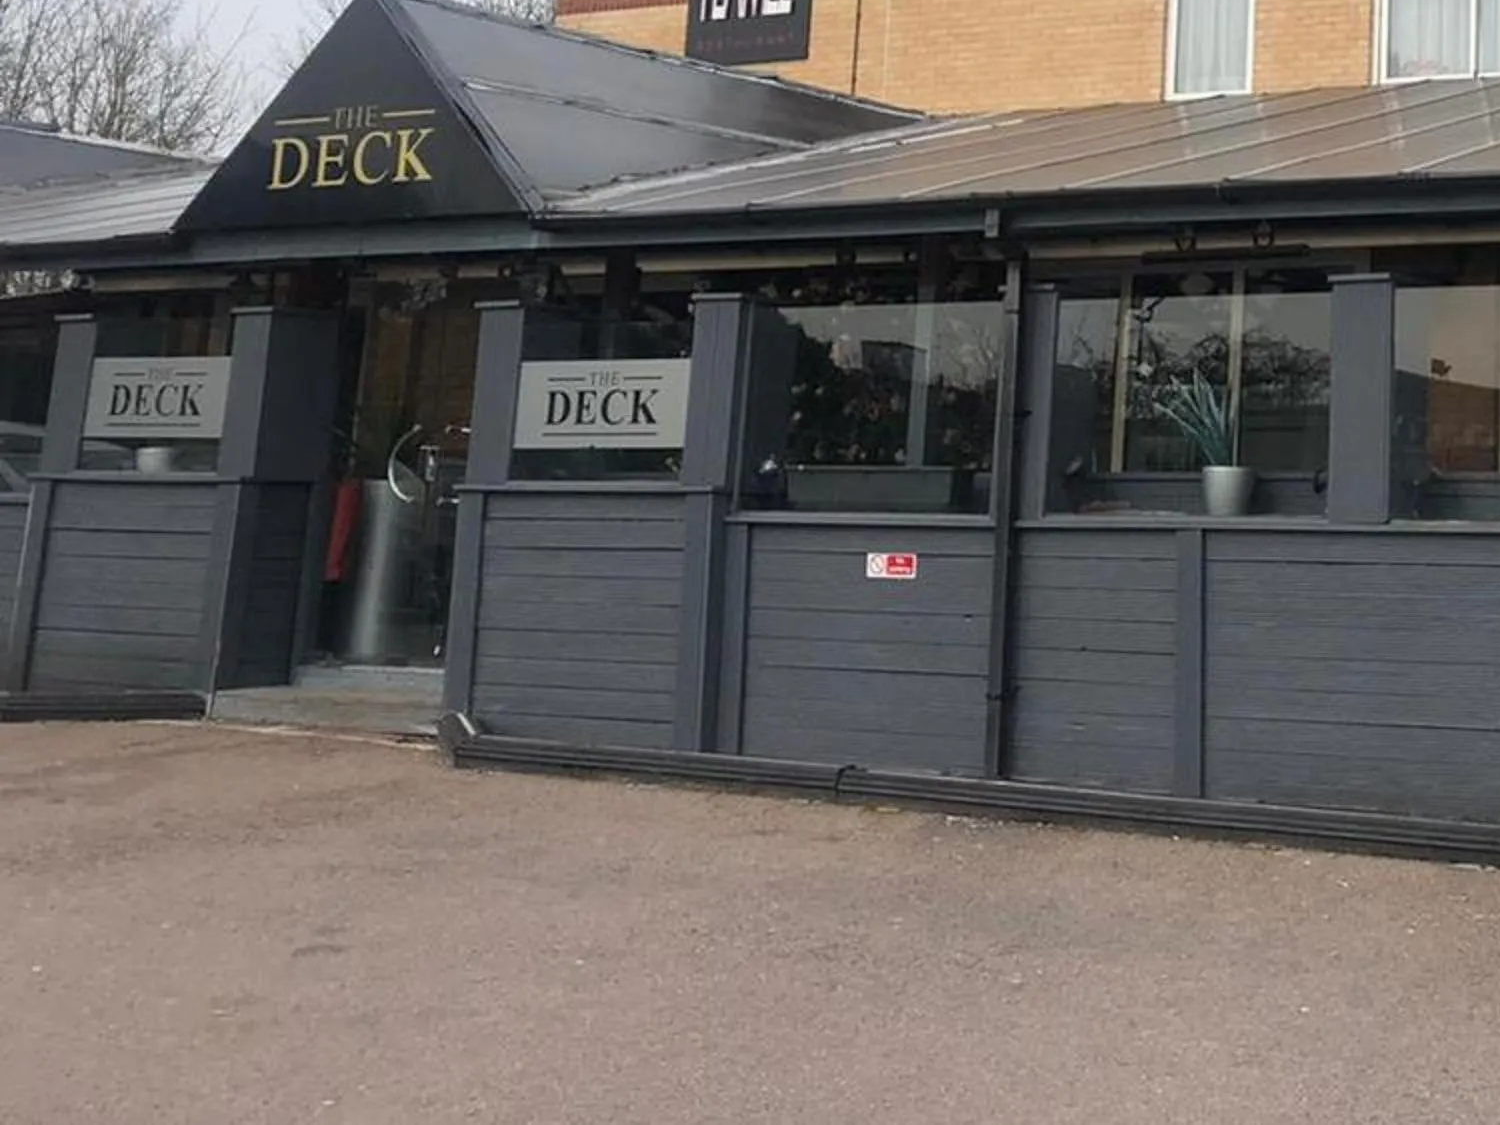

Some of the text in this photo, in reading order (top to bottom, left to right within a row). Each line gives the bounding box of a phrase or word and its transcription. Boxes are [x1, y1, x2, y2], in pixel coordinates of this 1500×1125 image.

[335, 104, 379, 129] THE
[266, 127, 436, 190] DECK
[590, 371, 622, 386] THE
[109, 383, 204, 416] DECK
[546, 388, 659, 425] DECK
